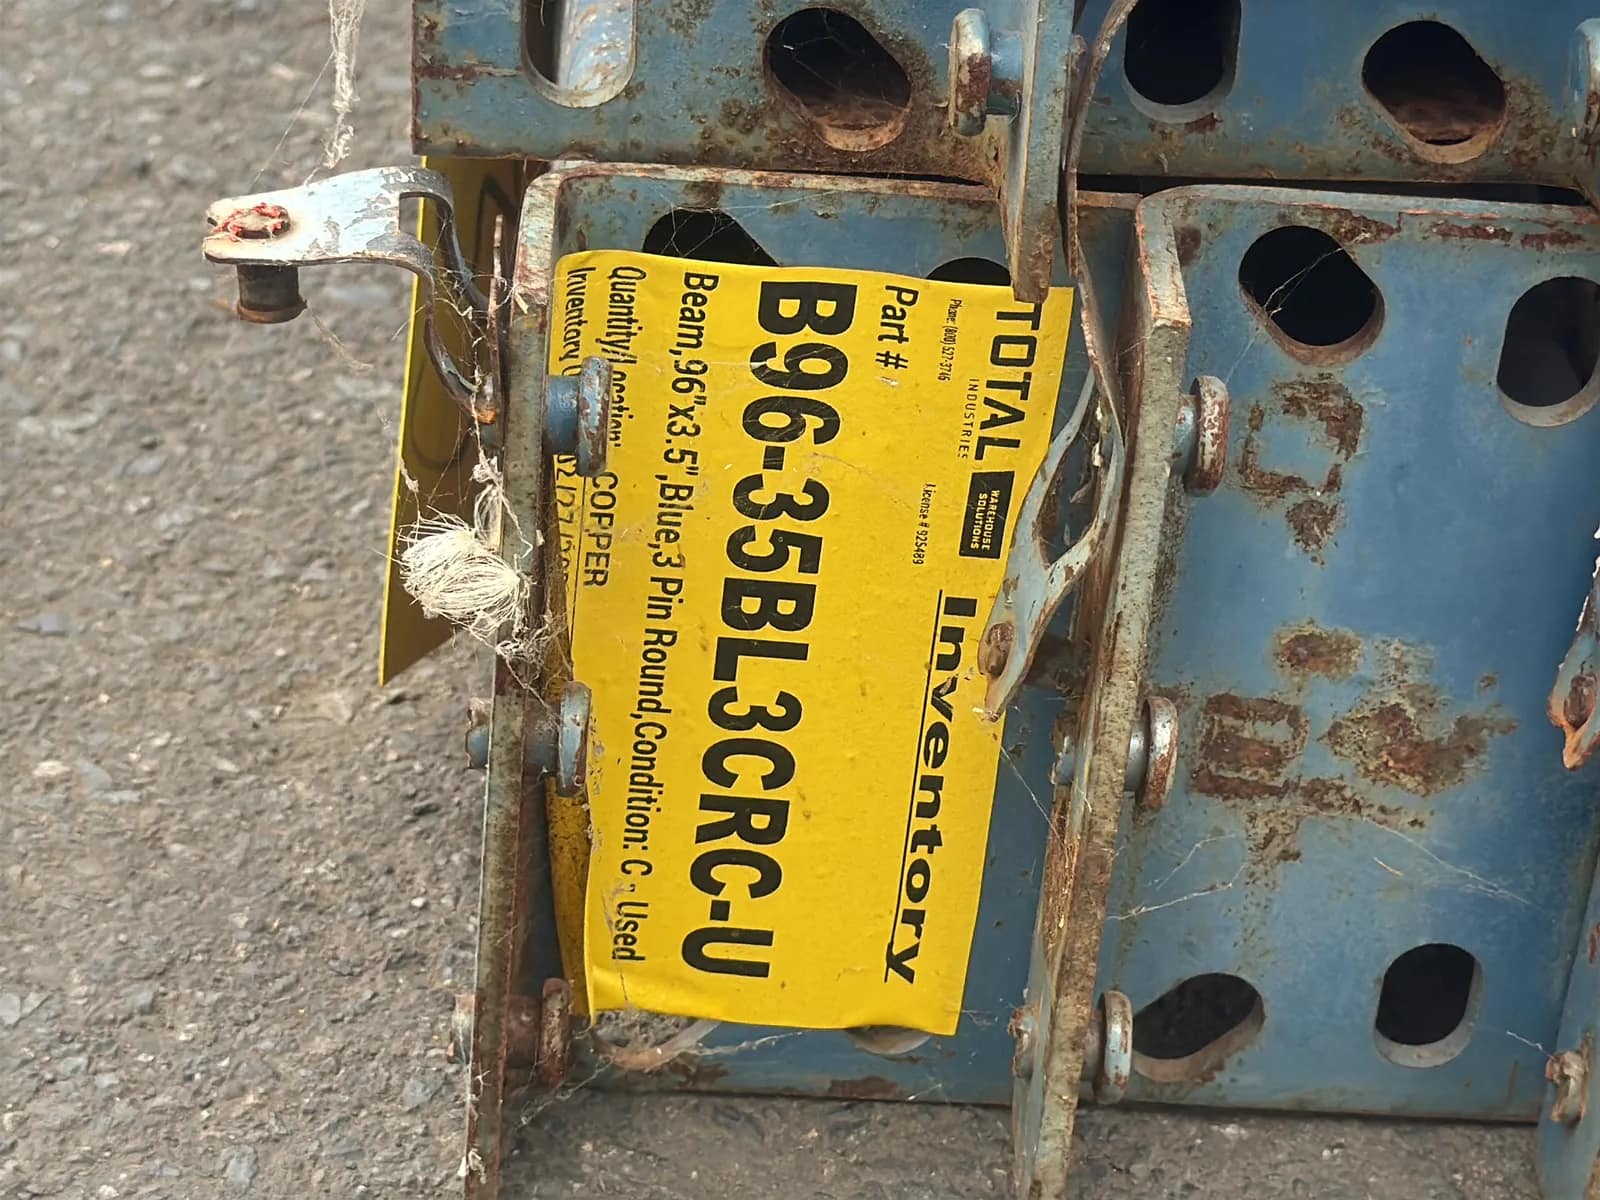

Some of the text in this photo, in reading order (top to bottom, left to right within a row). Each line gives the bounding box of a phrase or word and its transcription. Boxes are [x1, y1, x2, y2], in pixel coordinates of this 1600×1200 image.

[558, 267, 596, 362] Inventory
[875, 285, 919, 370] Part #
[941, 325, 958, 349] (800)
[937, 346, 955, 381] 527-3746
[975, 302, 1042, 460] TOTAL
[957, 378, 980, 459] INDUSTRIES
[583, 472, 618, 587] COPPER
[919, 483, 937, 518] License
[970, 492, 988, 550] SOLUTIONS
[981, 490, 1000, 551] WAREHOUSE
[912, 529, 929, 565] 925489
[646, 577, 684, 620] Pin
[681, 281, 857, 979] B96-35BL3CRC-U
[622, 628, 678, 850] Round,Condition:
[885, 595, 978, 984] Inventory
[621, 859, 653, 876] C
[612, 901, 649, 961] Used
